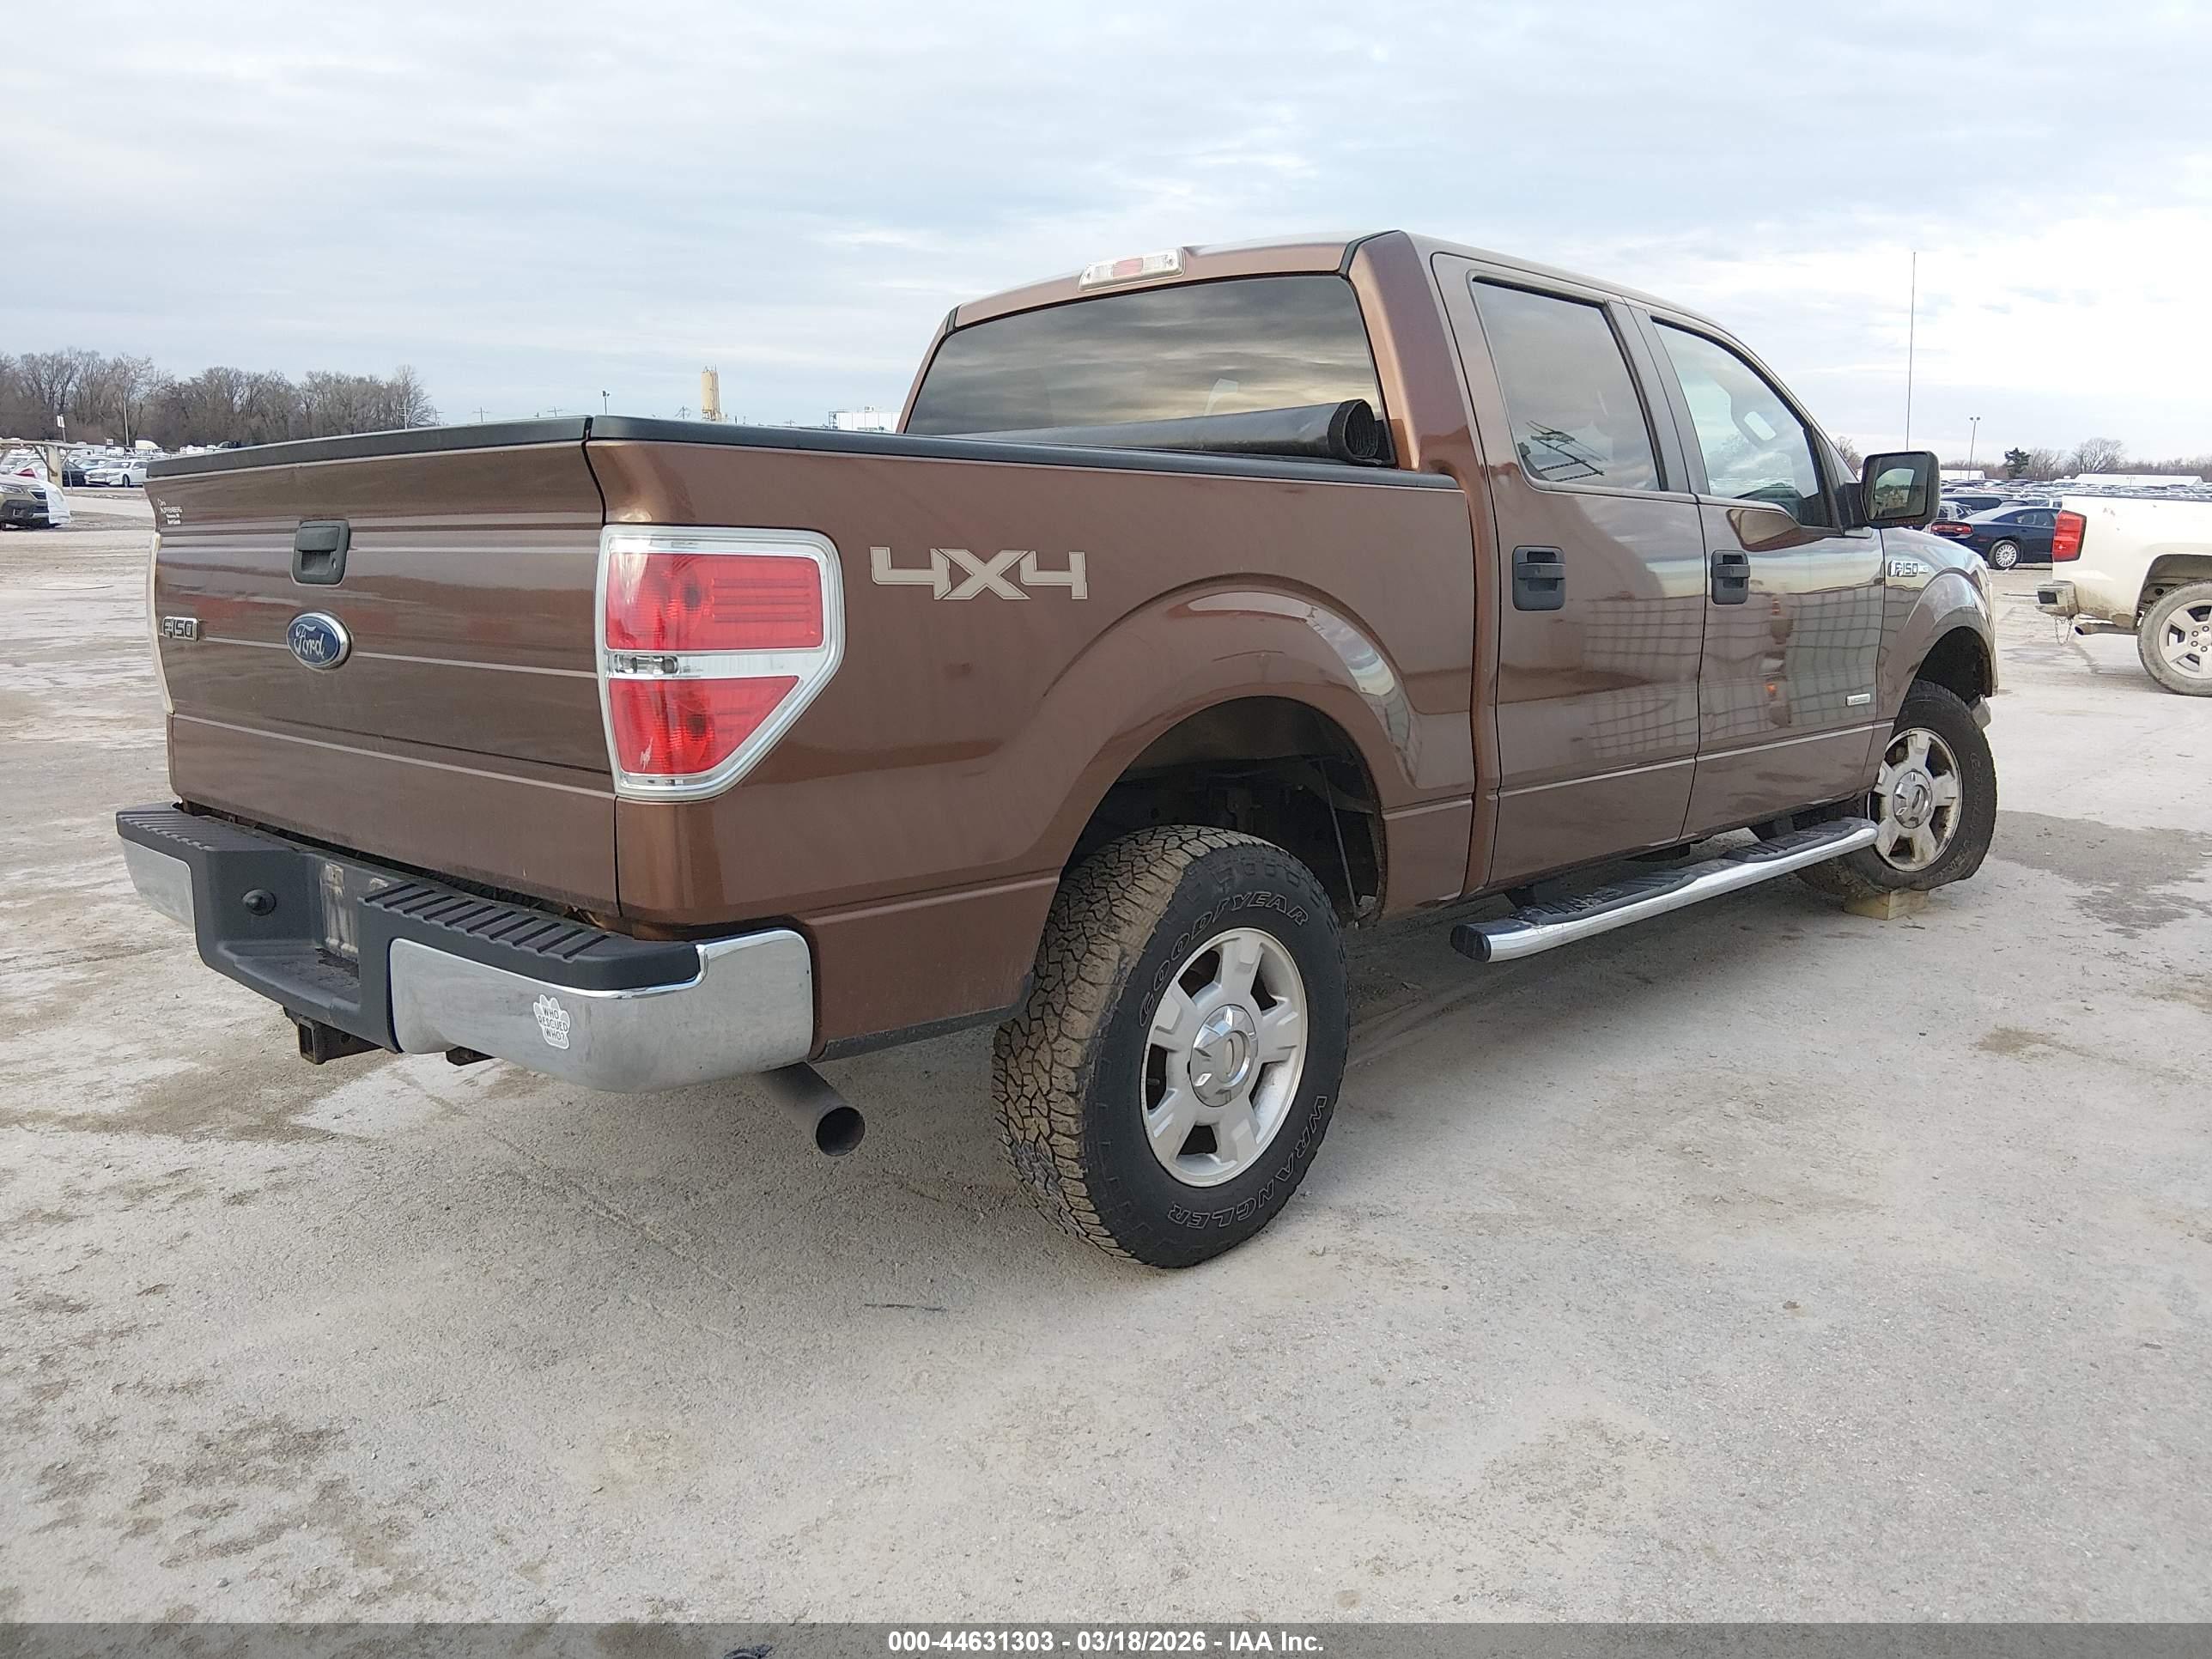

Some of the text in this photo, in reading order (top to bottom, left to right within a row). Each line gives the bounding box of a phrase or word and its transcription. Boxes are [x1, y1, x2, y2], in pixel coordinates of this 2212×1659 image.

[869, 546, 1088, 600] 4X4
[294, 623, 325, 659] Ford
[1139, 890, 1309, 1027] GOODYEAR
[538, 1015, 568, 1032] RESCUED
[542, 1006, 560, 1020] WHO
[544, 1027, 565, 1041] WHO?
[1167, 1095, 1328, 1230] WRANGLER
